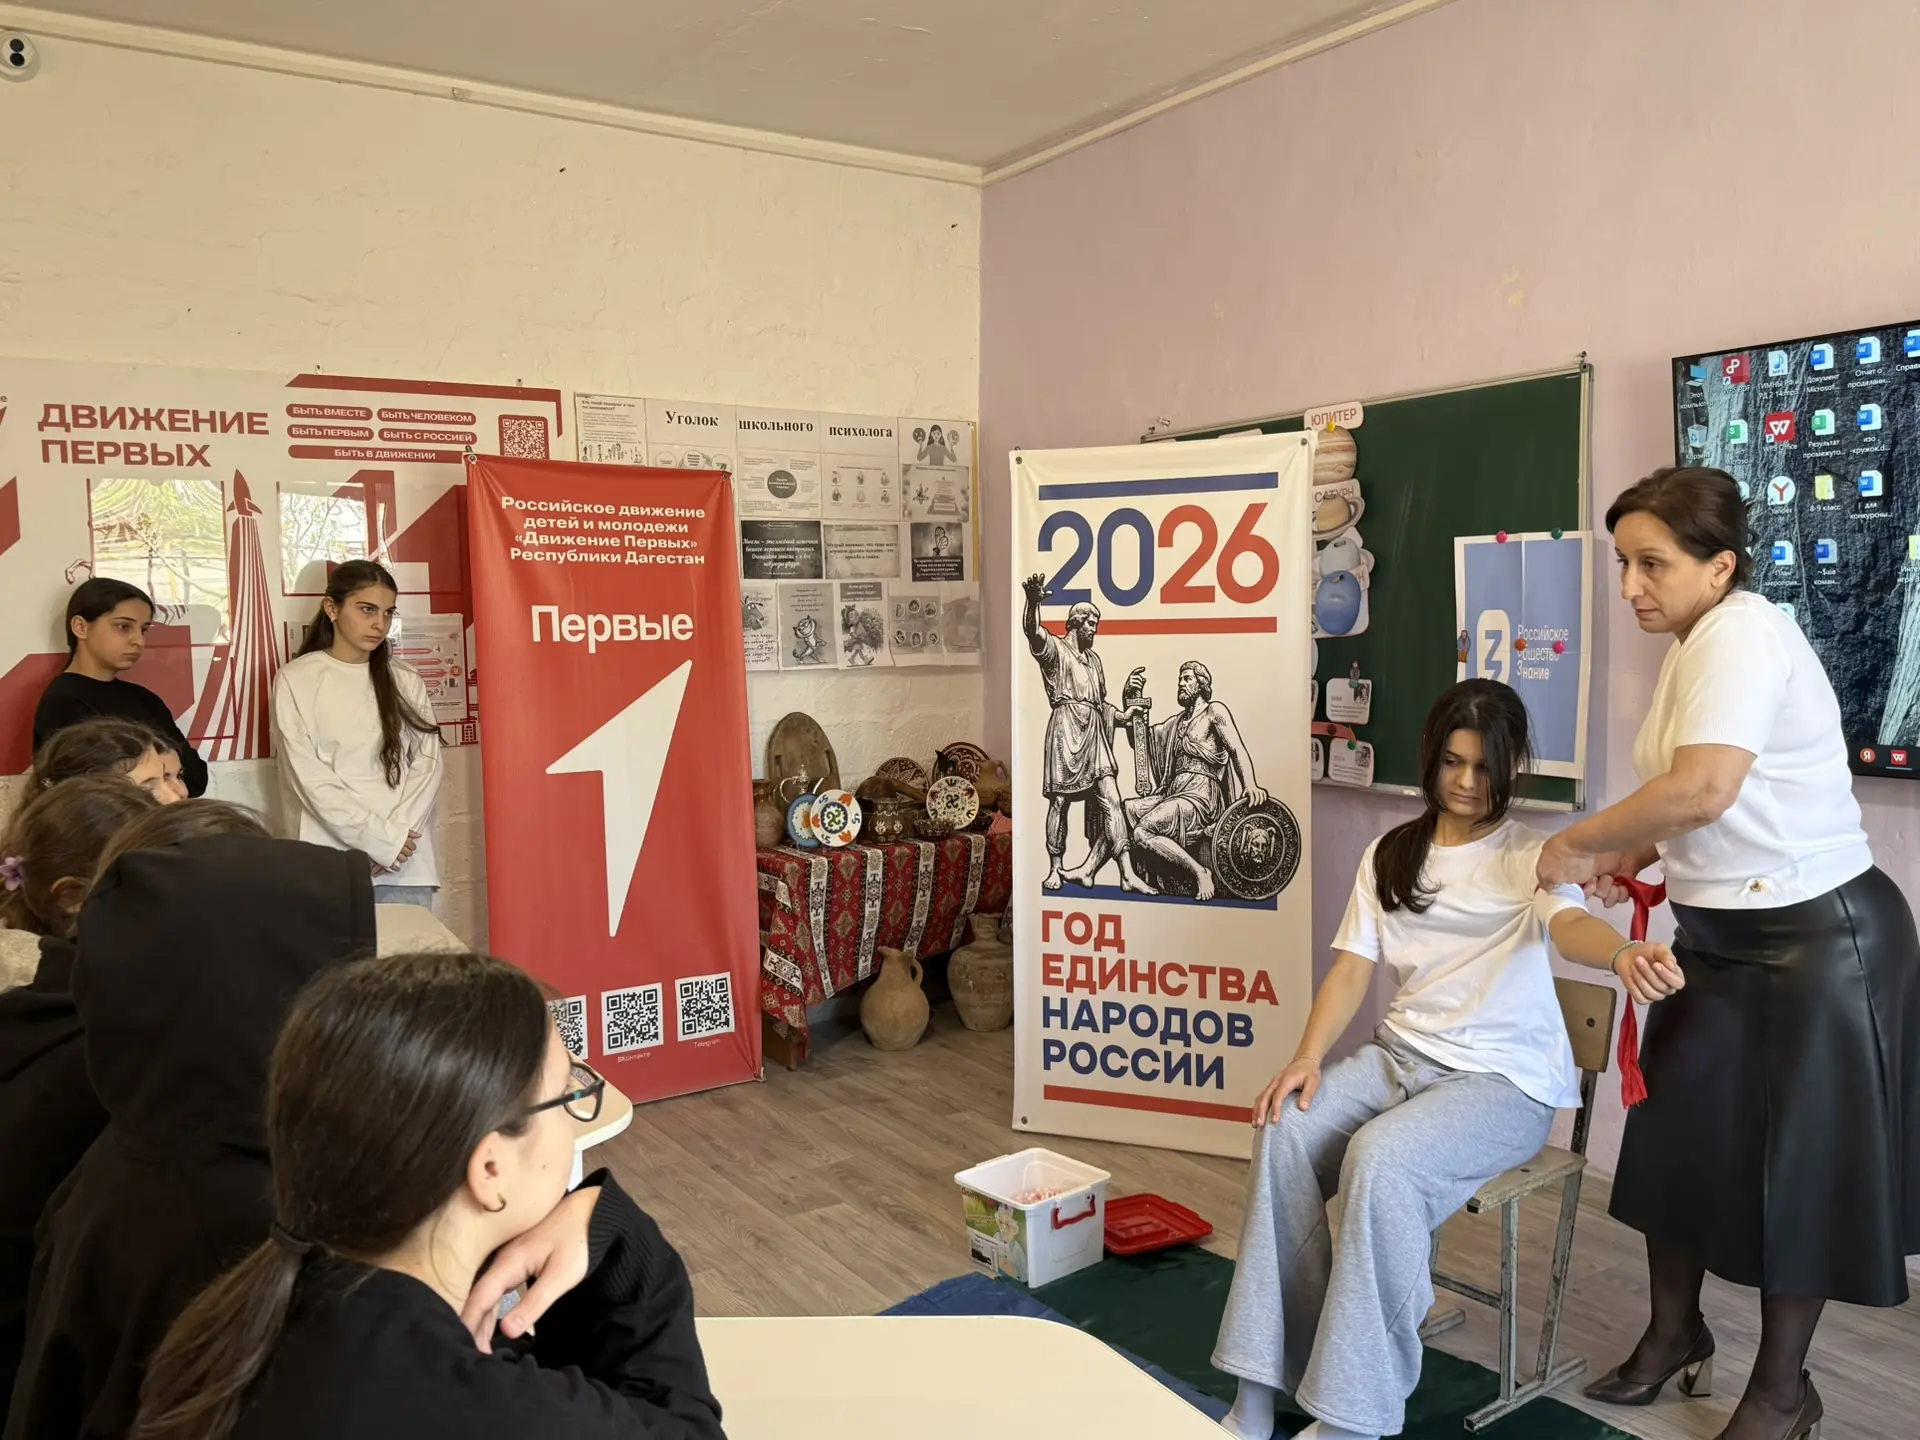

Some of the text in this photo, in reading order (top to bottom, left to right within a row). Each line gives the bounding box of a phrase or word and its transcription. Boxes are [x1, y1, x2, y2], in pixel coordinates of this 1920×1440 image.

[1806, 374, 1840, 384] Документ
[37, 403, 270, 435] ДВИЖЕНИЕ
[293, 407, 367, 418] БЫТЬ ВМЕСТЕ
[381, 411, 472, 423] БЫТЬ ЧЕЛОВЕКОМ
[1311, 408, 1357, 427] ЮПИТЕР
[292, 427, 369, 438] БЫТЬ ПЕРВЫМ
[665, 410, 893, 438] Уголок школьного психолога
[384, 431, 472, 442] БЫТЬ С РОССИЕЙ
[1808, 440, 1840, 448] Результат
[41, 439, 212, 467] ПЕРВЫХ
[334, 449, 436, 460] БЫТЬ В ДВИЖЕНИИ
[501, 496, 706, 518] Российское движение
[524, 516, 688, 534] детей и молодежи
[515, 532, 698, 550] «Движение Первых»
[510, 548, 705, 565] Республики Дагестан
[1038, 502, 1280, 607] 2026
[531, 605, 694, 654] Первые
[1517, 624, 1569, 641] Российское
[1516, 660, 1550, 680] Знание
[1042, 910, 1125, 954] ГОД
[1042, 953, 1280, 1006] ЕДИНСТВА
[1042, 996, 1254, 1048] НАРОДОВ
[694, 1038, 721, 1048] Telegram
[1043, 1038, 1224, 1090] РОССИИ
